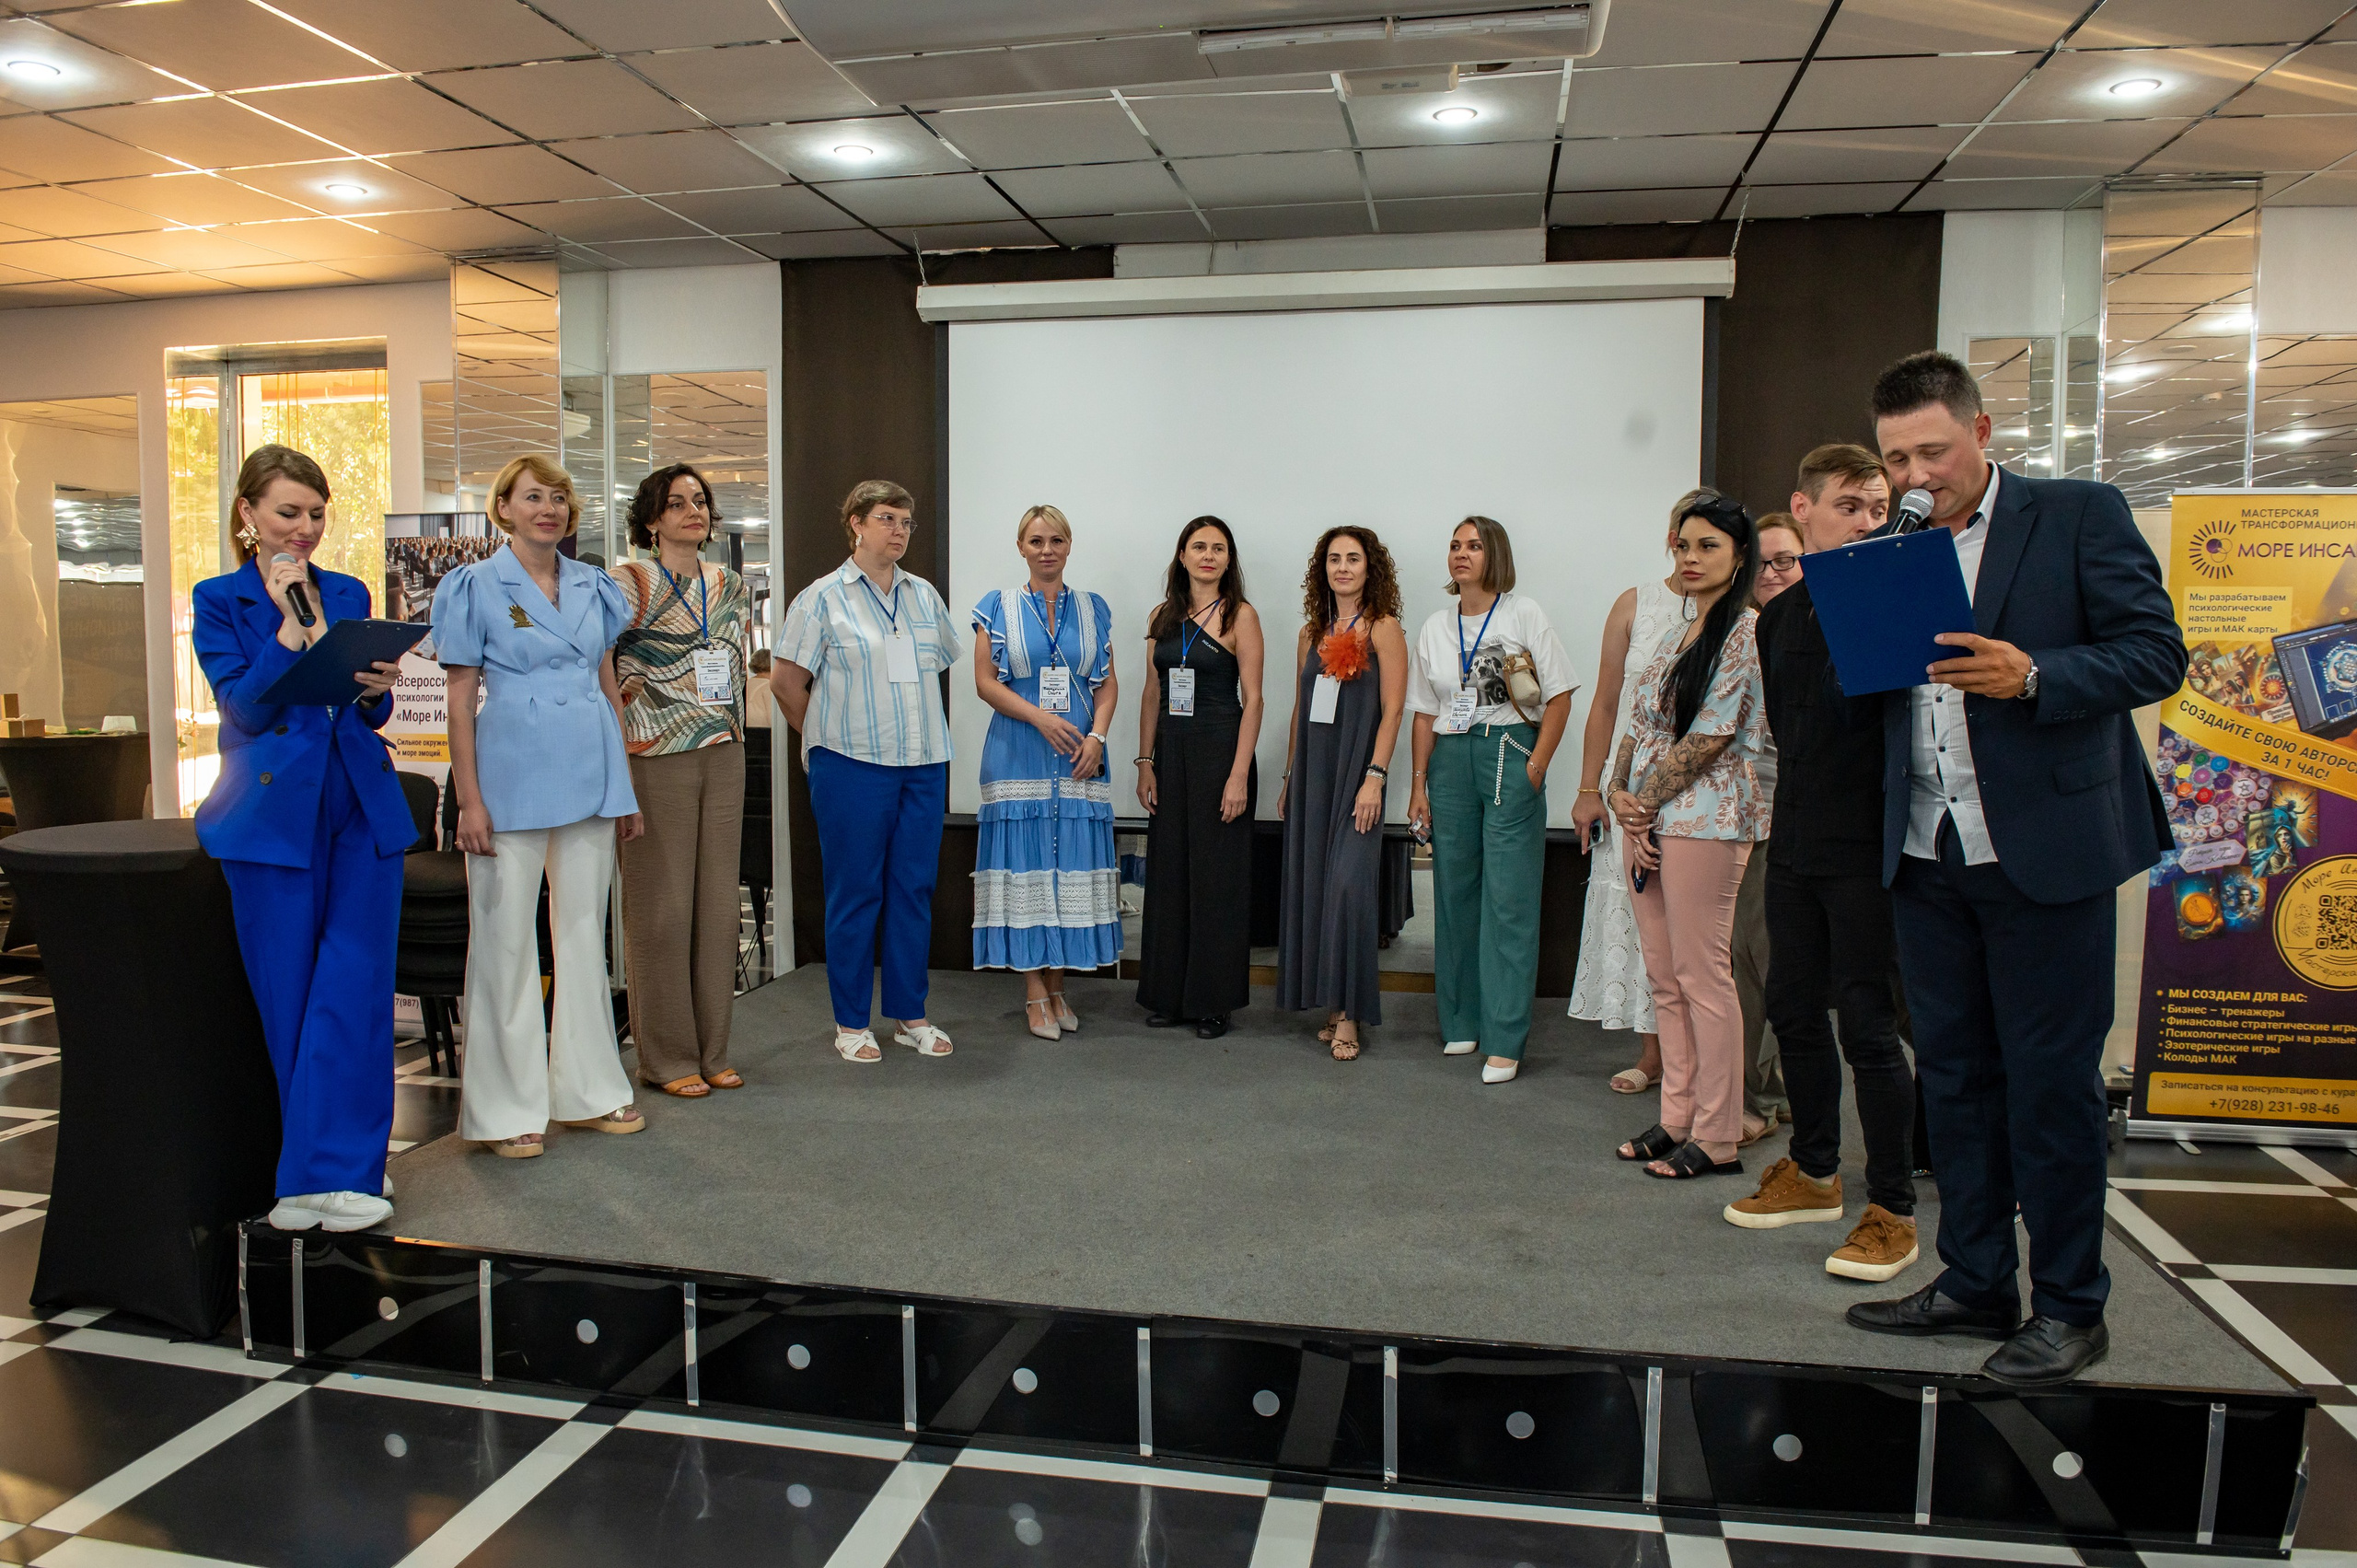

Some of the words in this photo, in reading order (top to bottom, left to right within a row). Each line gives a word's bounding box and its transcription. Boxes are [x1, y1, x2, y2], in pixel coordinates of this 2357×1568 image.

[2241, 508, 2319, 517] МАСТЕРСКАЯ
[2241, 520, 2357, 530] ТРАНСФОРМАЦИОН
[2237, 542, 2293, 558] МОРЕ
[2299, 542, 2356, 558] ИНСА
[2189, 593, 2207, 601] Мы
[2210, 593, 2286, 602] разрабатываем
[2189, 604, 2273, 612] психологические
[2188, 626, 2212, 634] игры
[2247, 626, 2280, 634] карты.
[396, 694, 444, 703] психологии
[396, 709, 431, 725] «Море
[2179, 700, 2253, 739] СОЗДАЙТЕ
[2254, 732, 2298, 753] СВОЮ
[2299, 747, 2357, 774] АВТОРС
[2260, 751, 2279, 766] ЗА
[2285, 759, 2292, 769] 1
[2297, 763, 2330, 781] ЧАС!
[2302, 869, 2332, 893] Море
[395, 997, 419, 1009] 7(987)
[2168, 988, 2189, 998] МЫ
[2192, 989, 2251, 1002] СОЗДАЕМ
[2252, 992, 2278, 1003] ДЛЯ
[2281, 993, 2308, 1003] ВАС:
[2167, 1004, 2207, 1014] Бизнес
[2221, 1007, 2285, 1017] тренажеры
[2166, 1016, 2239, 1028] Финансовые
[2241, 1020, 2330, 1032] стратегические
[2165, 1028, 2264, 1040] Психологические
[2267, 1034, 2294, 1043] игры
[2296, 1035, 2312, 1043] на
[2313, 1035, 2357, 1045] разные
[2165, 1040, 2250, 1052] Эзотерические
[2252, 1045, 2281, 1055] игры
[2164, 1051, 2208, 1063] Колоды
[2211, 1053, 2237, 1063] МАК
[2161, 1080, 2223, 1091] Записаться
[2242, 1085, 2319, 1097] консультацию
[2210, 1098, 2264, 1114] +7(928)
[2268, 1101, 2340, 1115] 231-98-46
